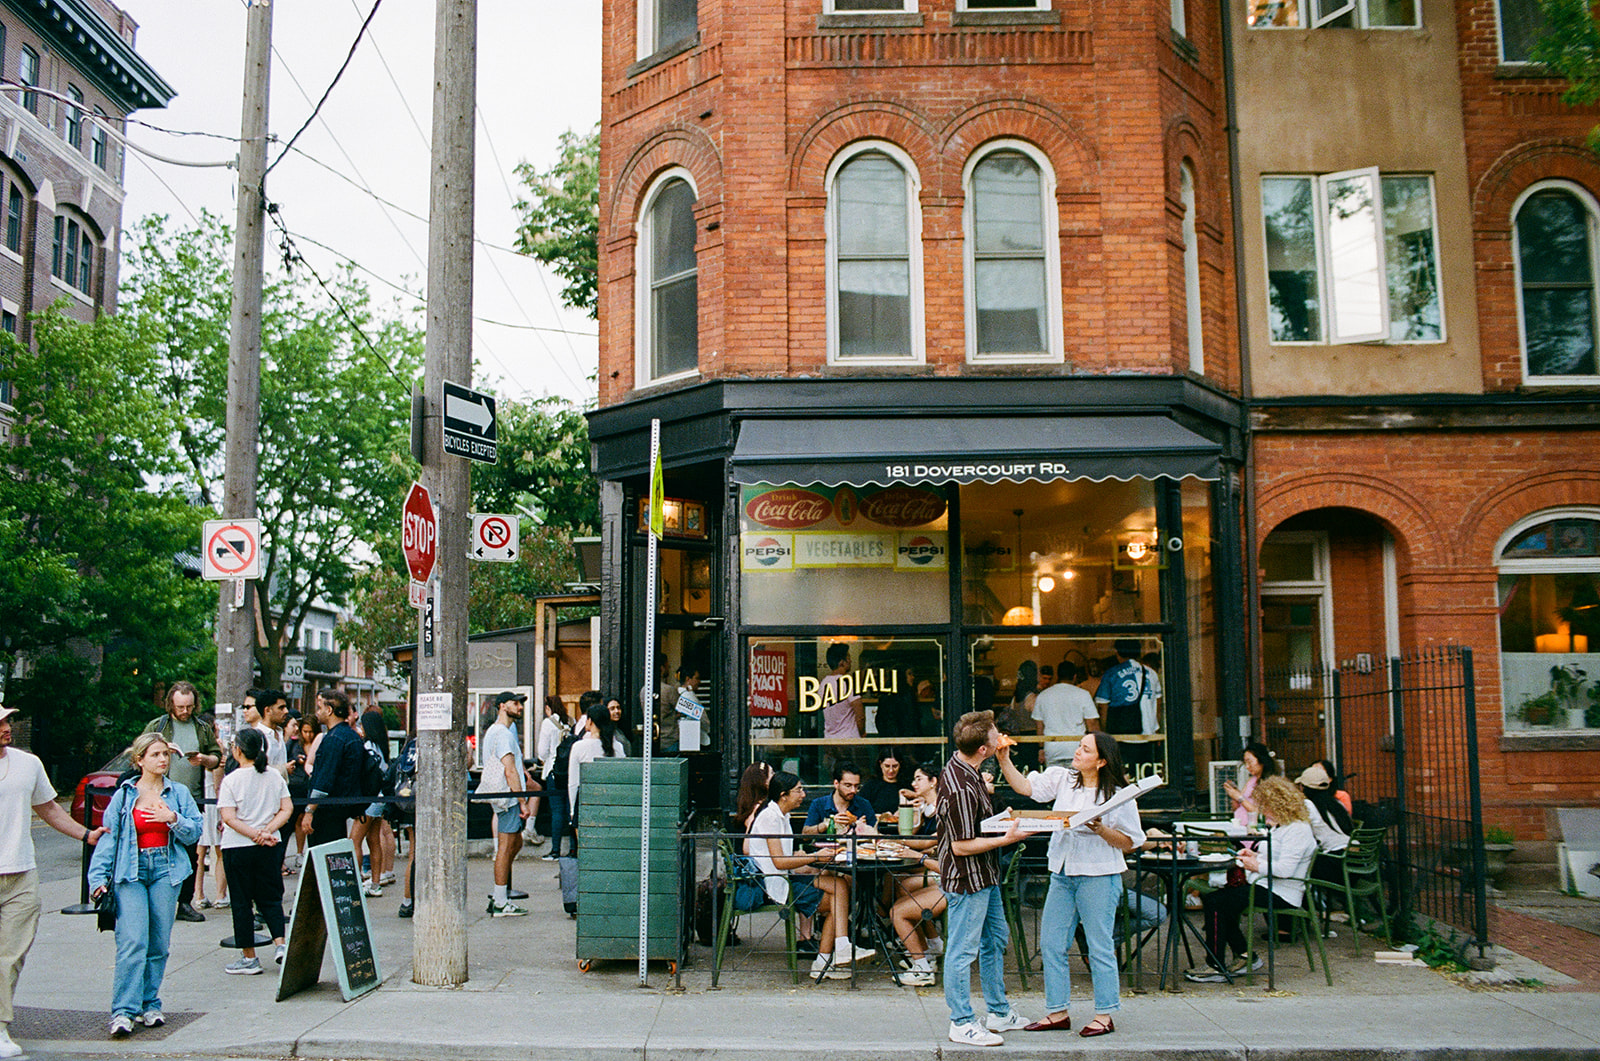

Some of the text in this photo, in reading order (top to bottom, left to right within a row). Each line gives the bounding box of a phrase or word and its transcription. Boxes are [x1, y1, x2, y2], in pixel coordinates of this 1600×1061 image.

[445, 434, 497, 459] BICYCLES EXCEPTED
[886, 465, 910, 478] 181
[914, 464, 1035, 477] DOVERCOURT
[771, 494, 798, 502] Drink
[405, 511, 434, 555] STOP
[745, 547, 791, 556] PEPSI
[806, 541, 884, 558] VEGETABLES
[898, 546, 944, 556] PEPSI
[287, 665, 303, 677] 30
[798, 668, 898, 712] BADIALI
[965, 1029, 977, 1038] N
